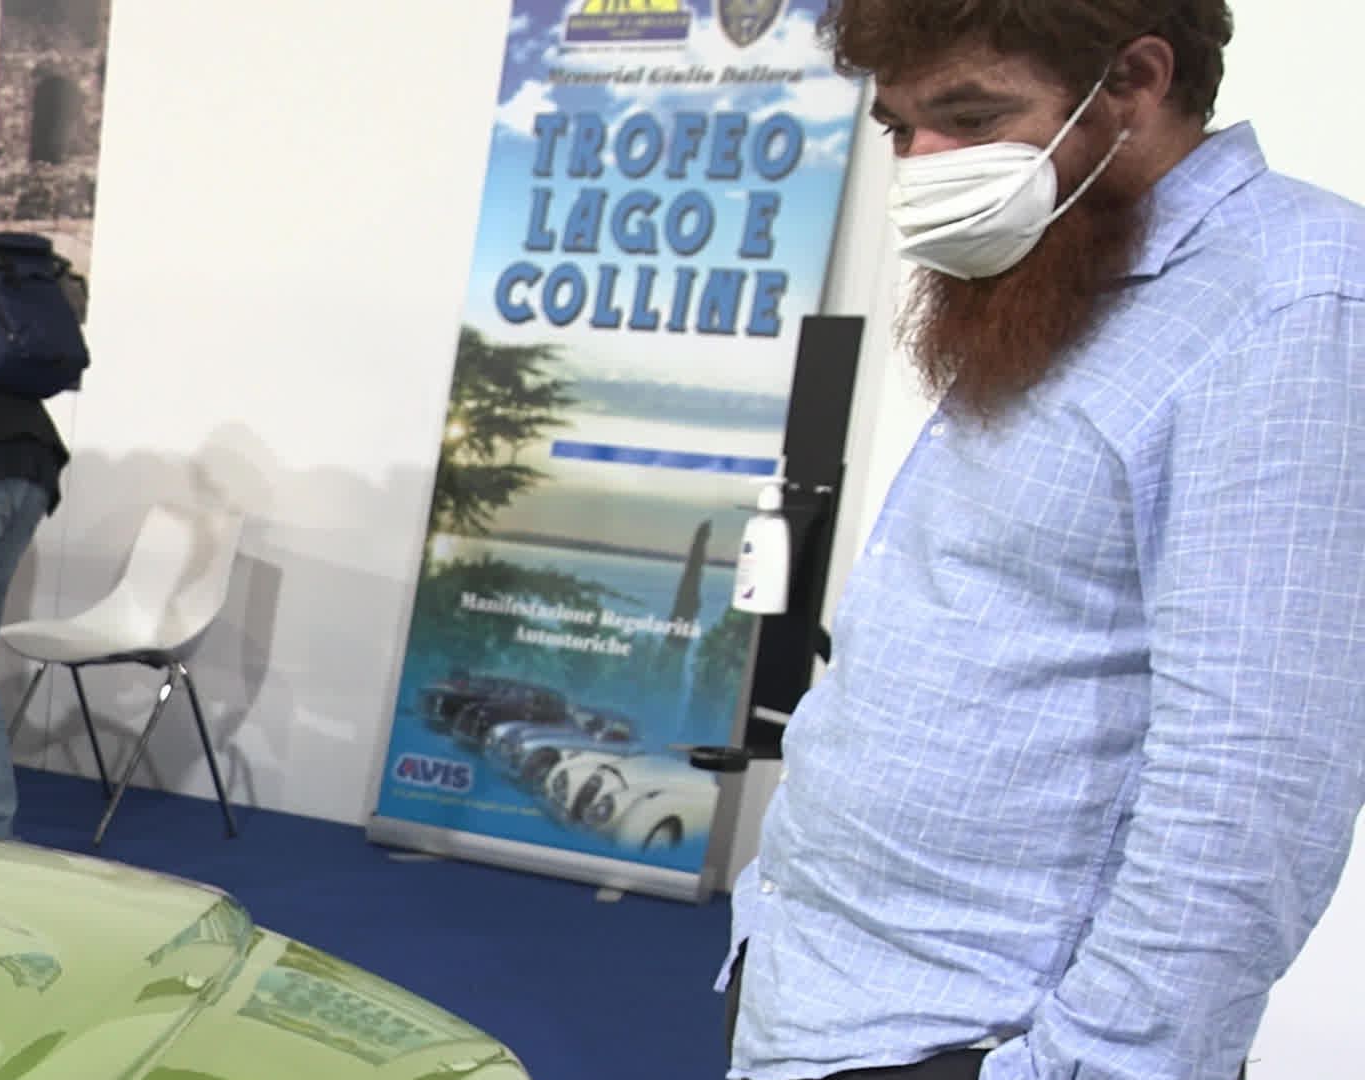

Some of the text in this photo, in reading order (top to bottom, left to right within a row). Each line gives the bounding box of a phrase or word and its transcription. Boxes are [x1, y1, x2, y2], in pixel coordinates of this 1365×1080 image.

[531, 112, 805, 181] TROFEO
[523, 188, 782, 260] LAGO E
[494, 261, 789, 337] COLLINE
[395, 754, 472, 791] AVIS
